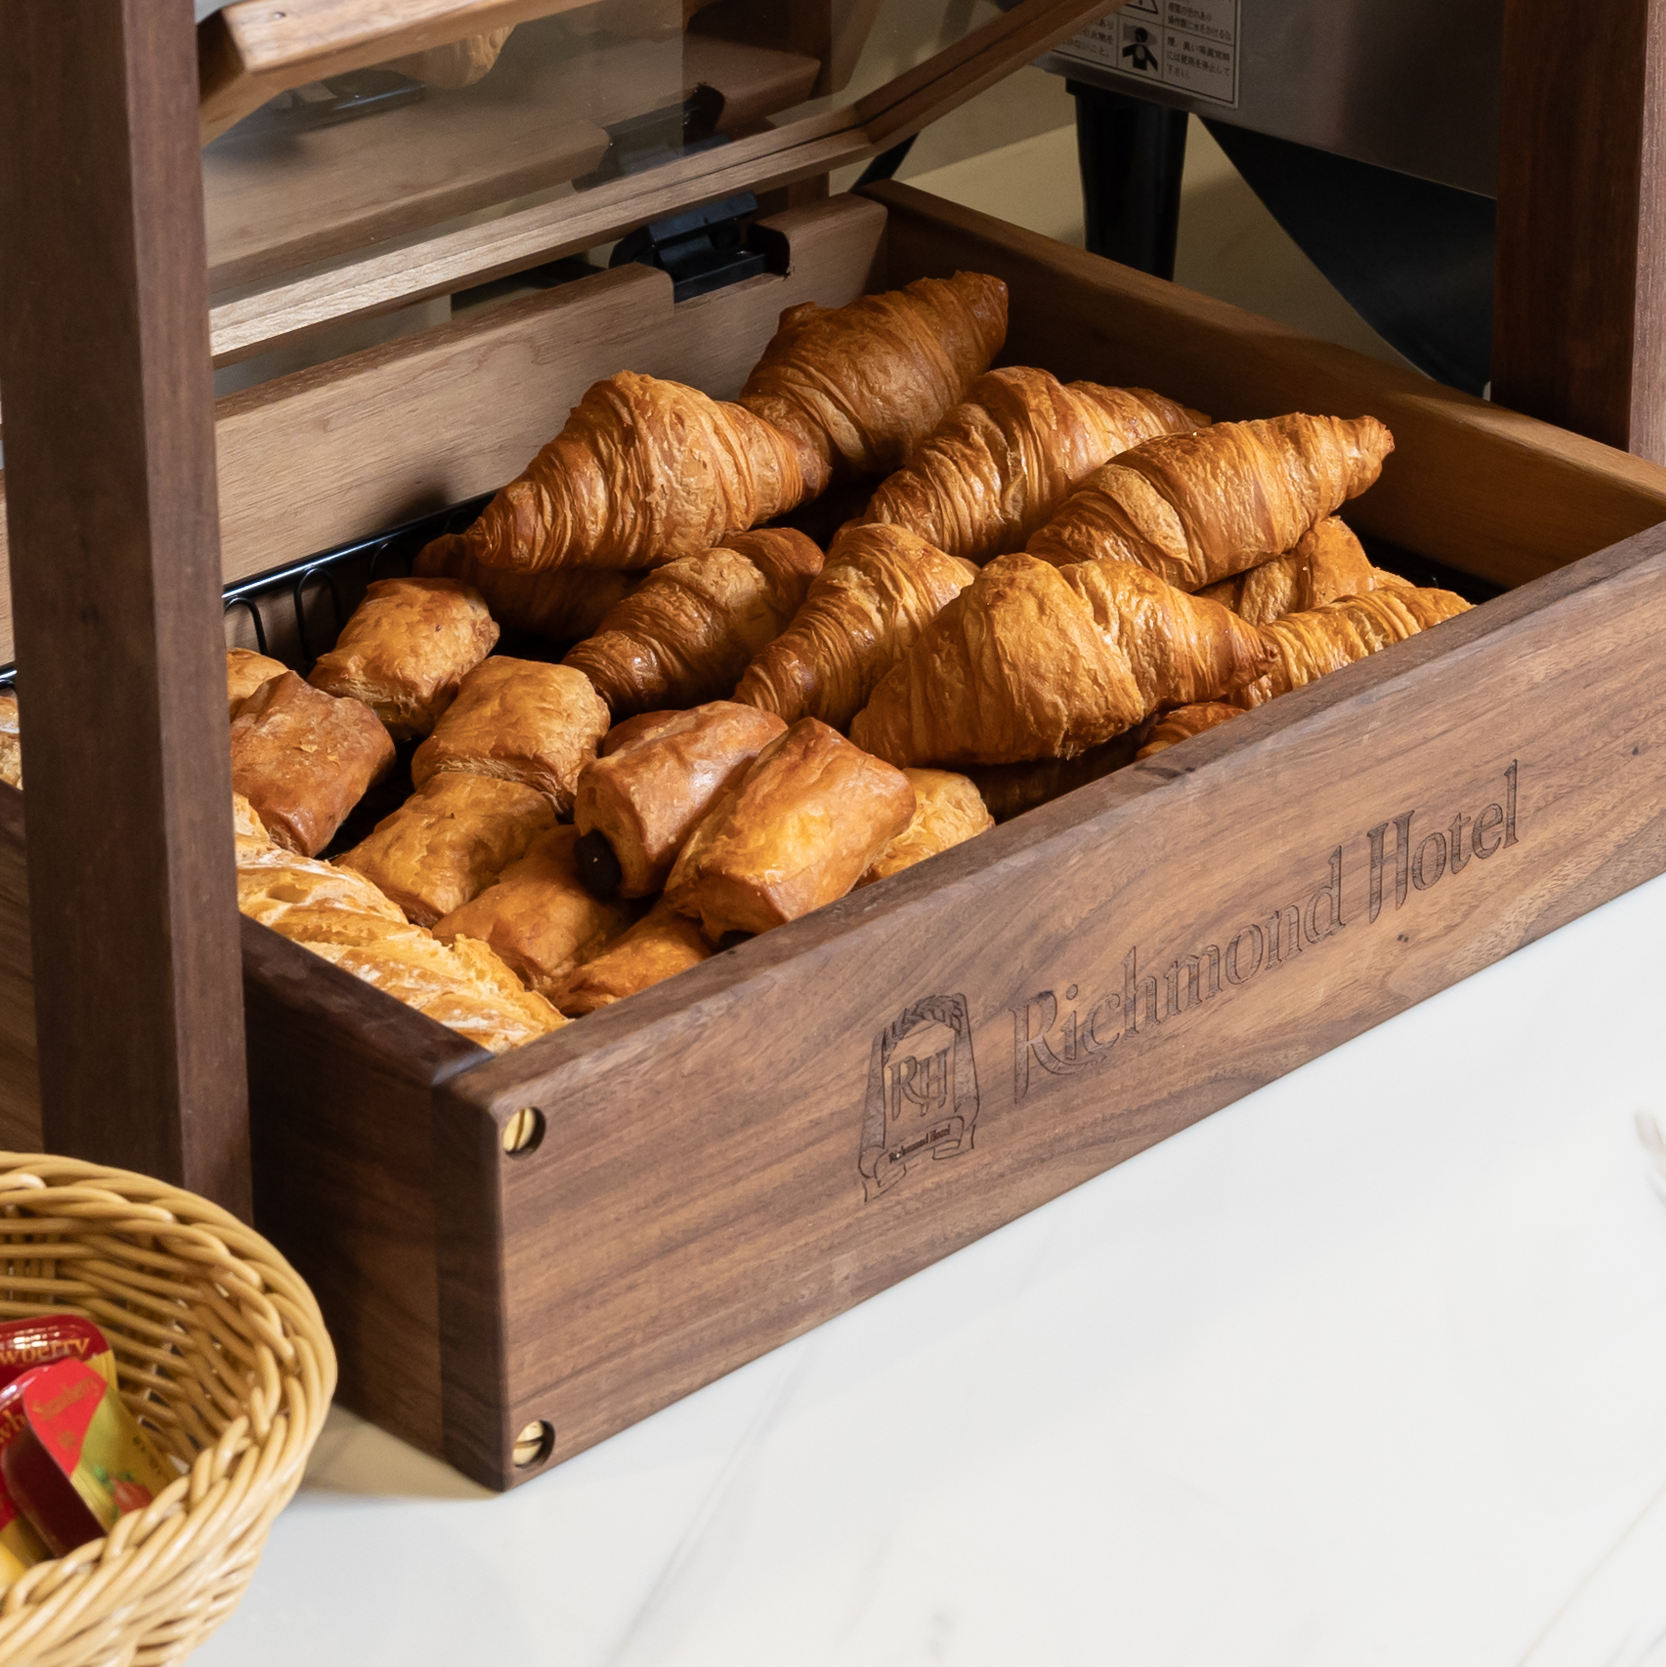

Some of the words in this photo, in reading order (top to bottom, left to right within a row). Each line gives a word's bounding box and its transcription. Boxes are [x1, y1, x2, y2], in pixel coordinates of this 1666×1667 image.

[1009, 845, 1346, 1105] Richmond
[1365, 758, 1521, 922] Hotel
[888, 1047, 951, 1122] RH
